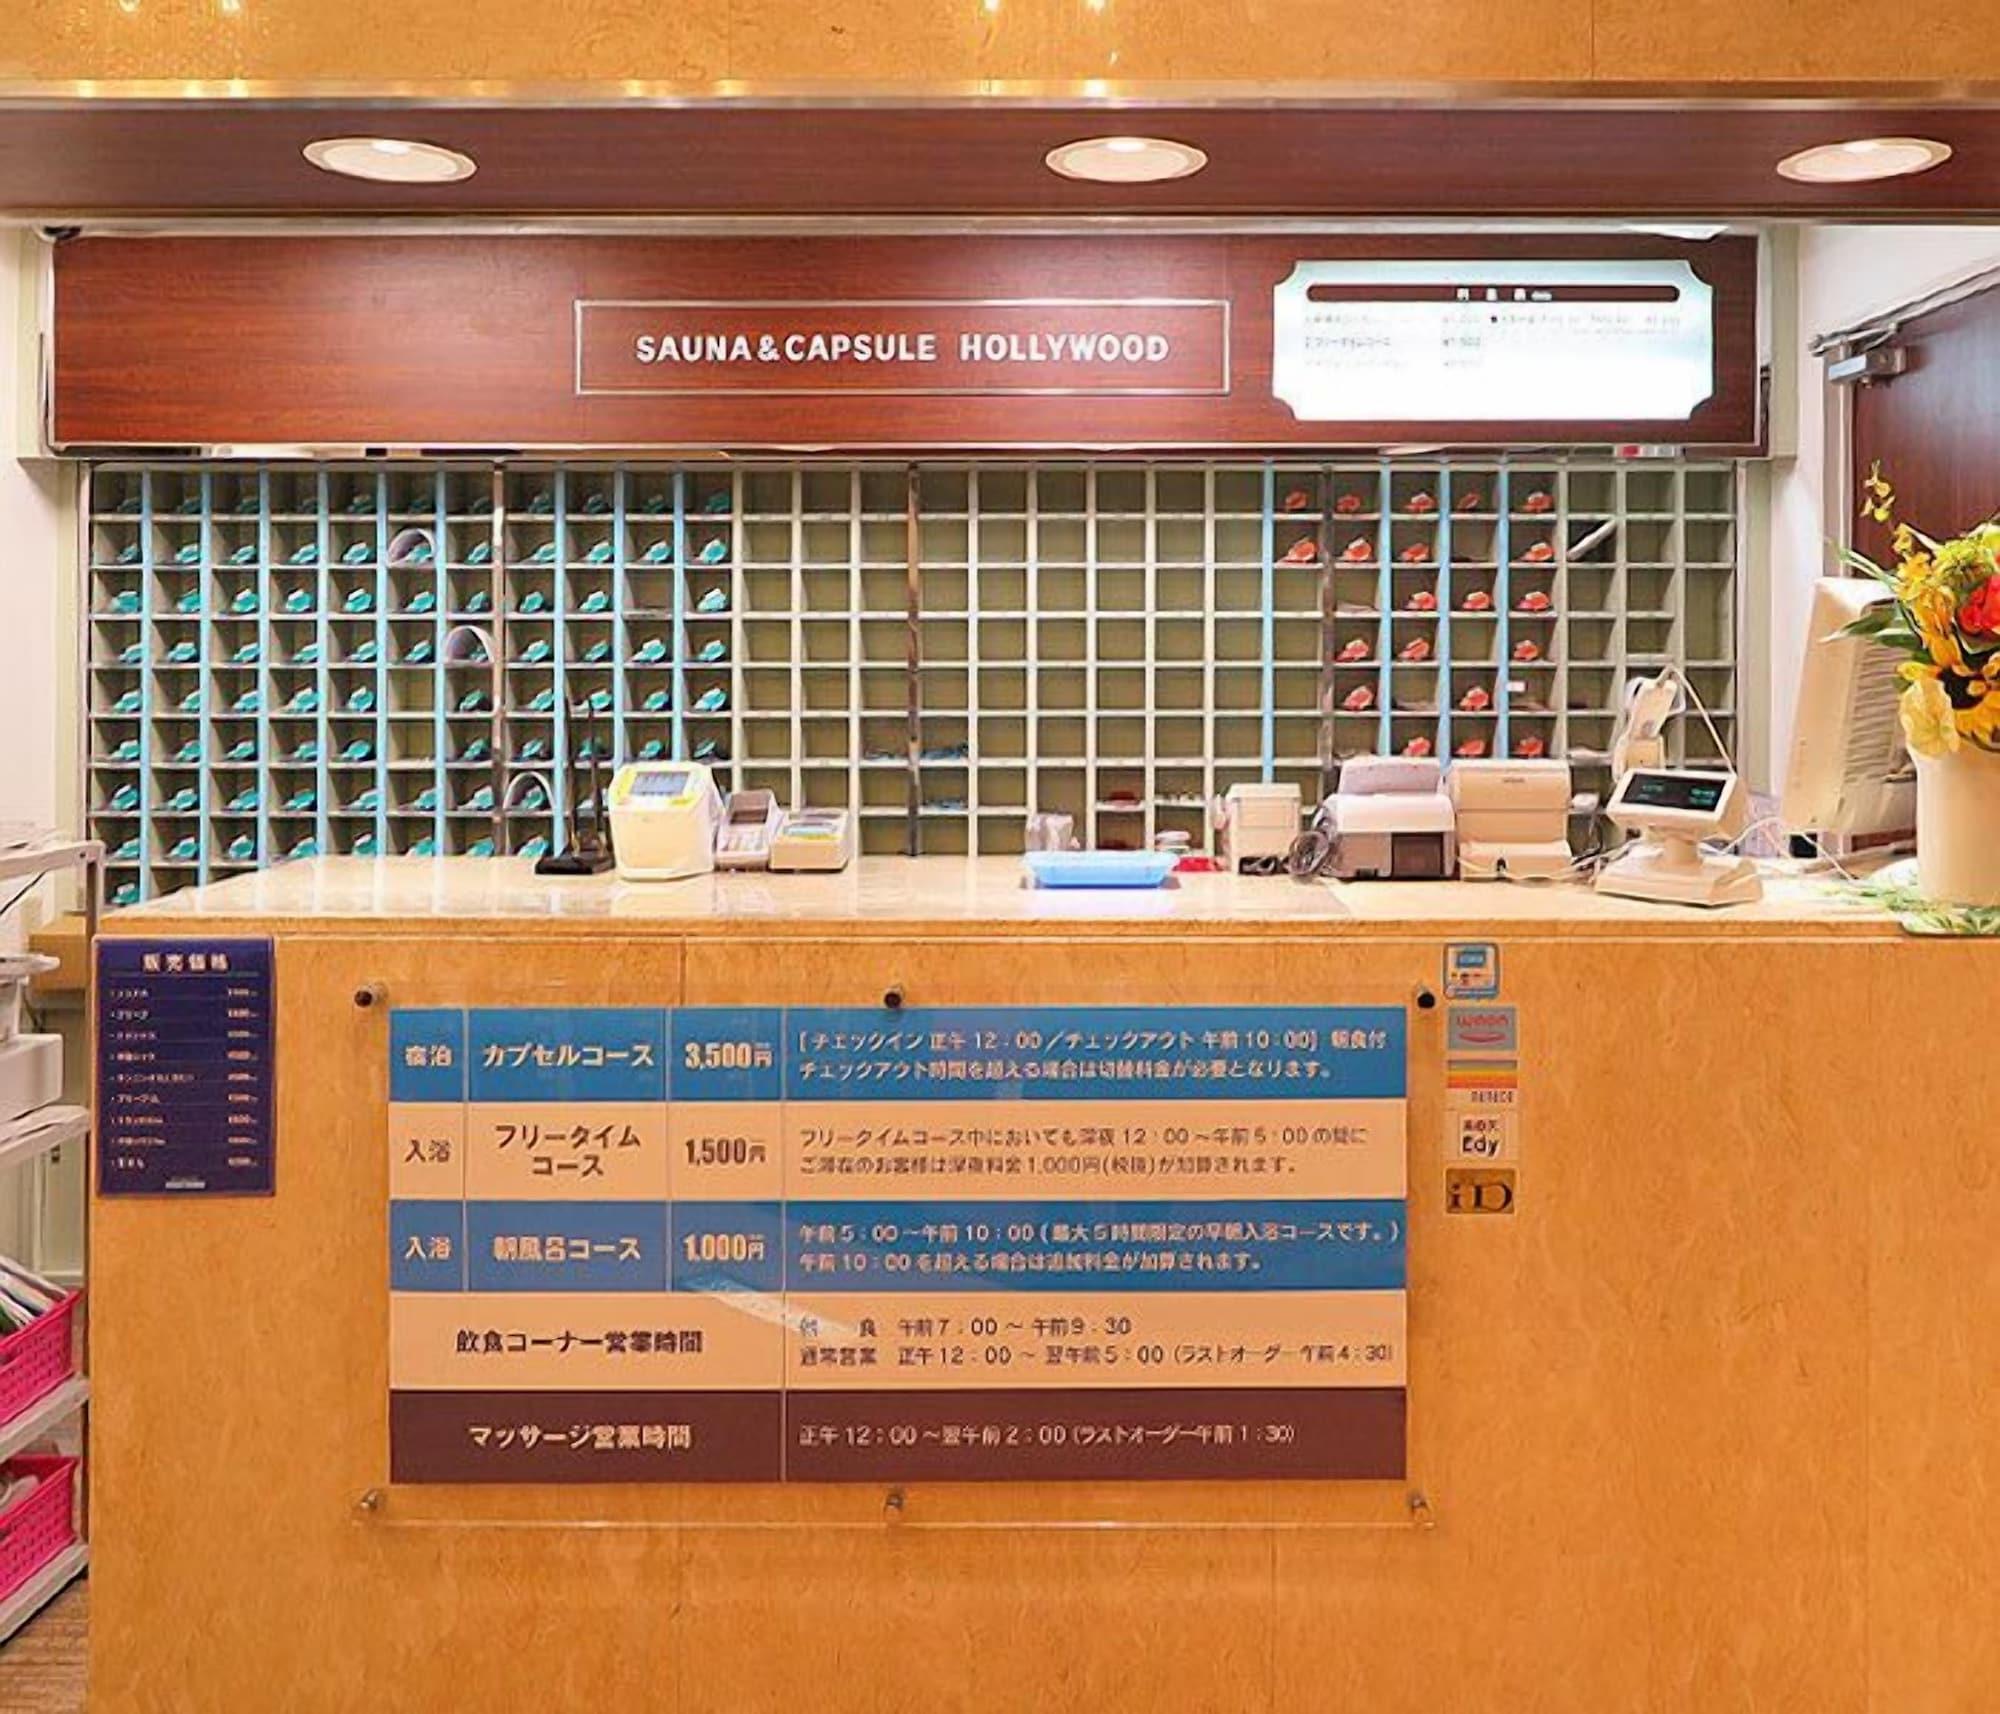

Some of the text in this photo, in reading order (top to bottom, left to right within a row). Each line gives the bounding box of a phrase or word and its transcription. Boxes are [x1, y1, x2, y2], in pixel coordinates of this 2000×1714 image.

[960, 333, 1169, 363] HOLLYWOOD
[405, 1044, 452, 1068] 宿泊
[684, 1042, 772, 1069] 3,500円
[495, 1124, 641, 1149] フリータイム
[1462, 1135, 1500, 1158] Edy
[405, 1139, 451, 1163] 入浴
[685, 1138, 767, 1166] 1,500円
[532, 1154, 604, 1177] コース
[1448, 1182, 1513, 1212] iD
[405, 1236, 451, 1259] 入浴
[493, 1236, 641, 1262] 朝風呂コース
[456, 1329, 703, 1354] 飲食コーナー営業時間
[469, 1424, 692, 1450] マッサージ営業時間
